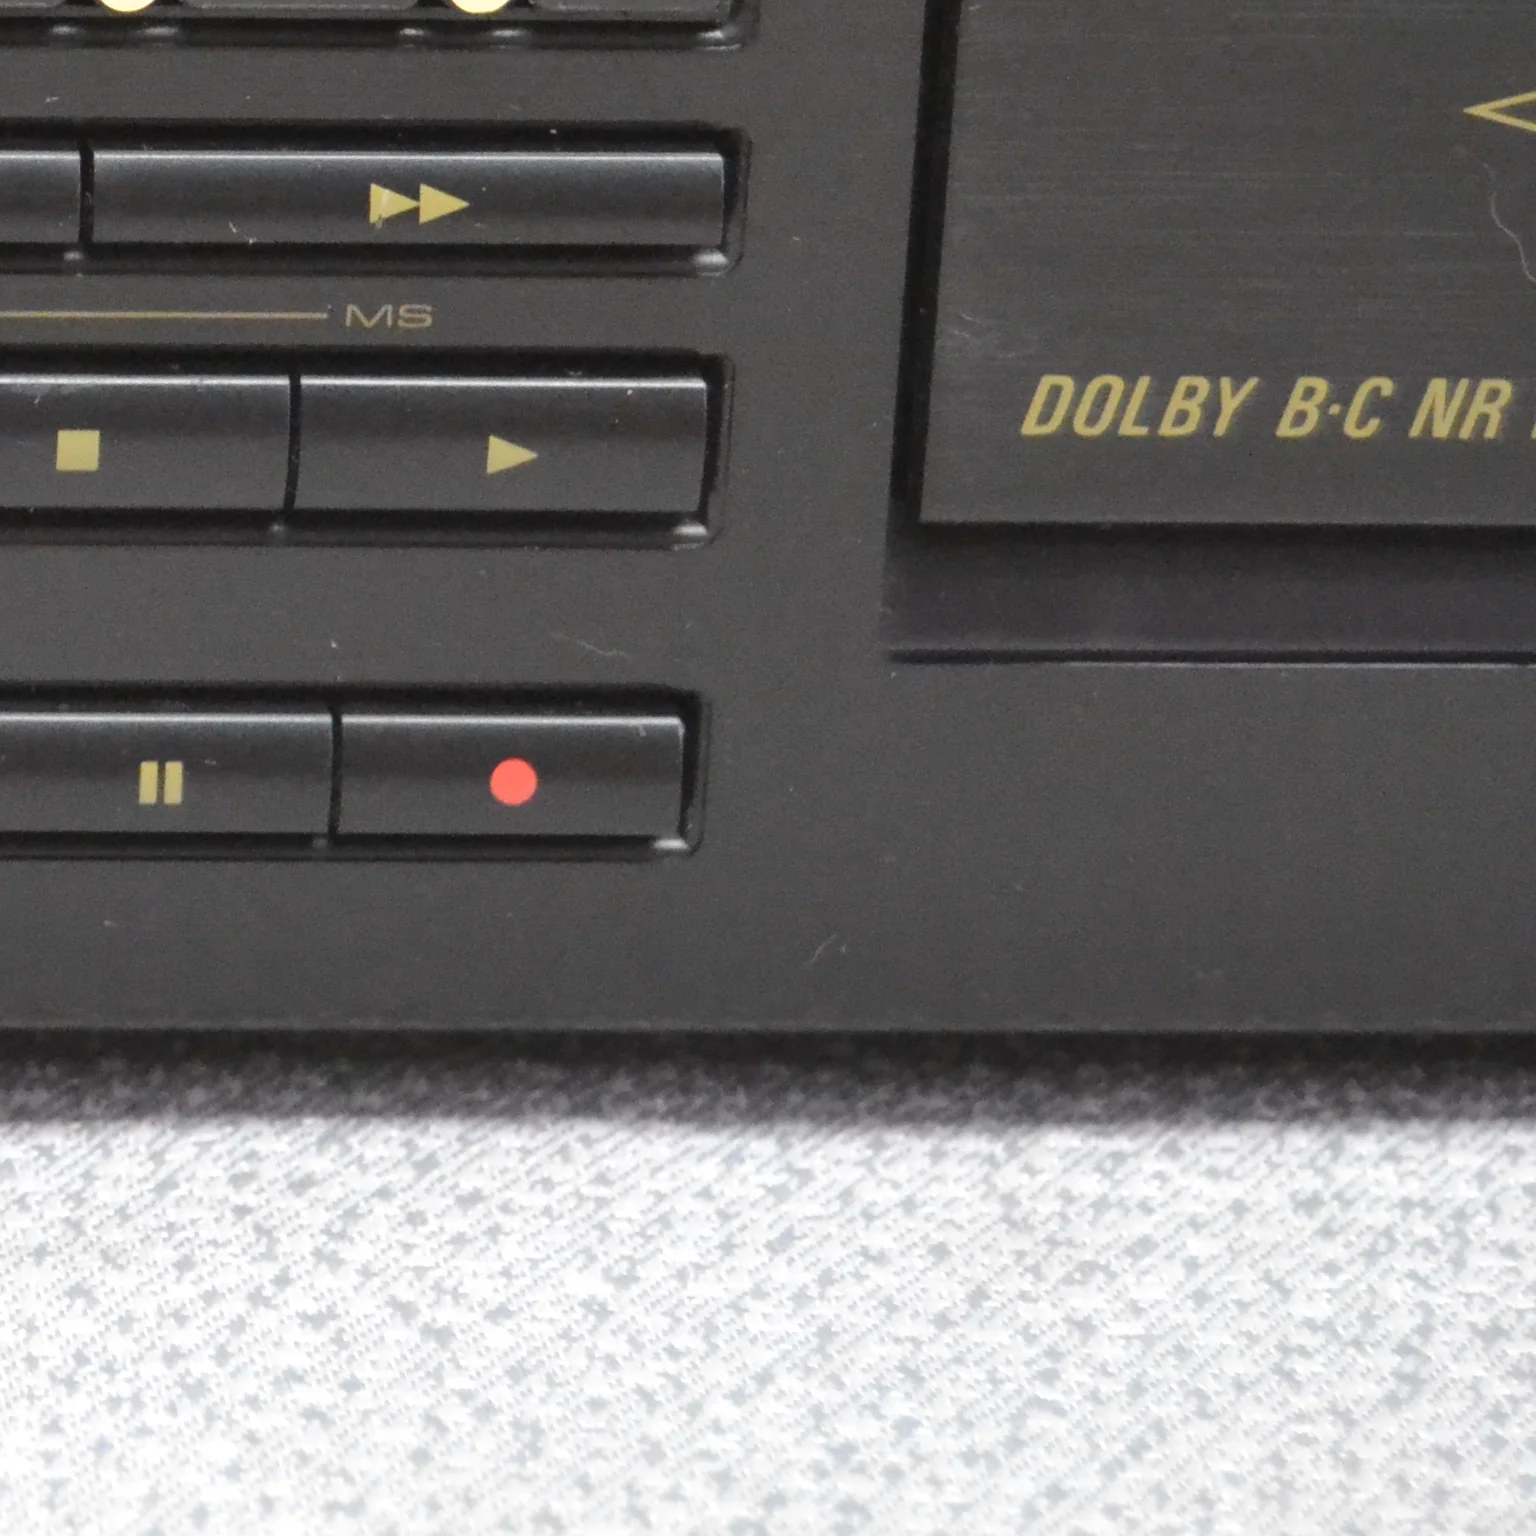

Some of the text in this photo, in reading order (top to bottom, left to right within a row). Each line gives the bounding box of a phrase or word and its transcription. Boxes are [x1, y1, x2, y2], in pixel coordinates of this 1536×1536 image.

[346, 304, 432, 328] MS
[1021, 375, 1258, 436] DOLBY
[1407, 376, 1514, 440] NR
